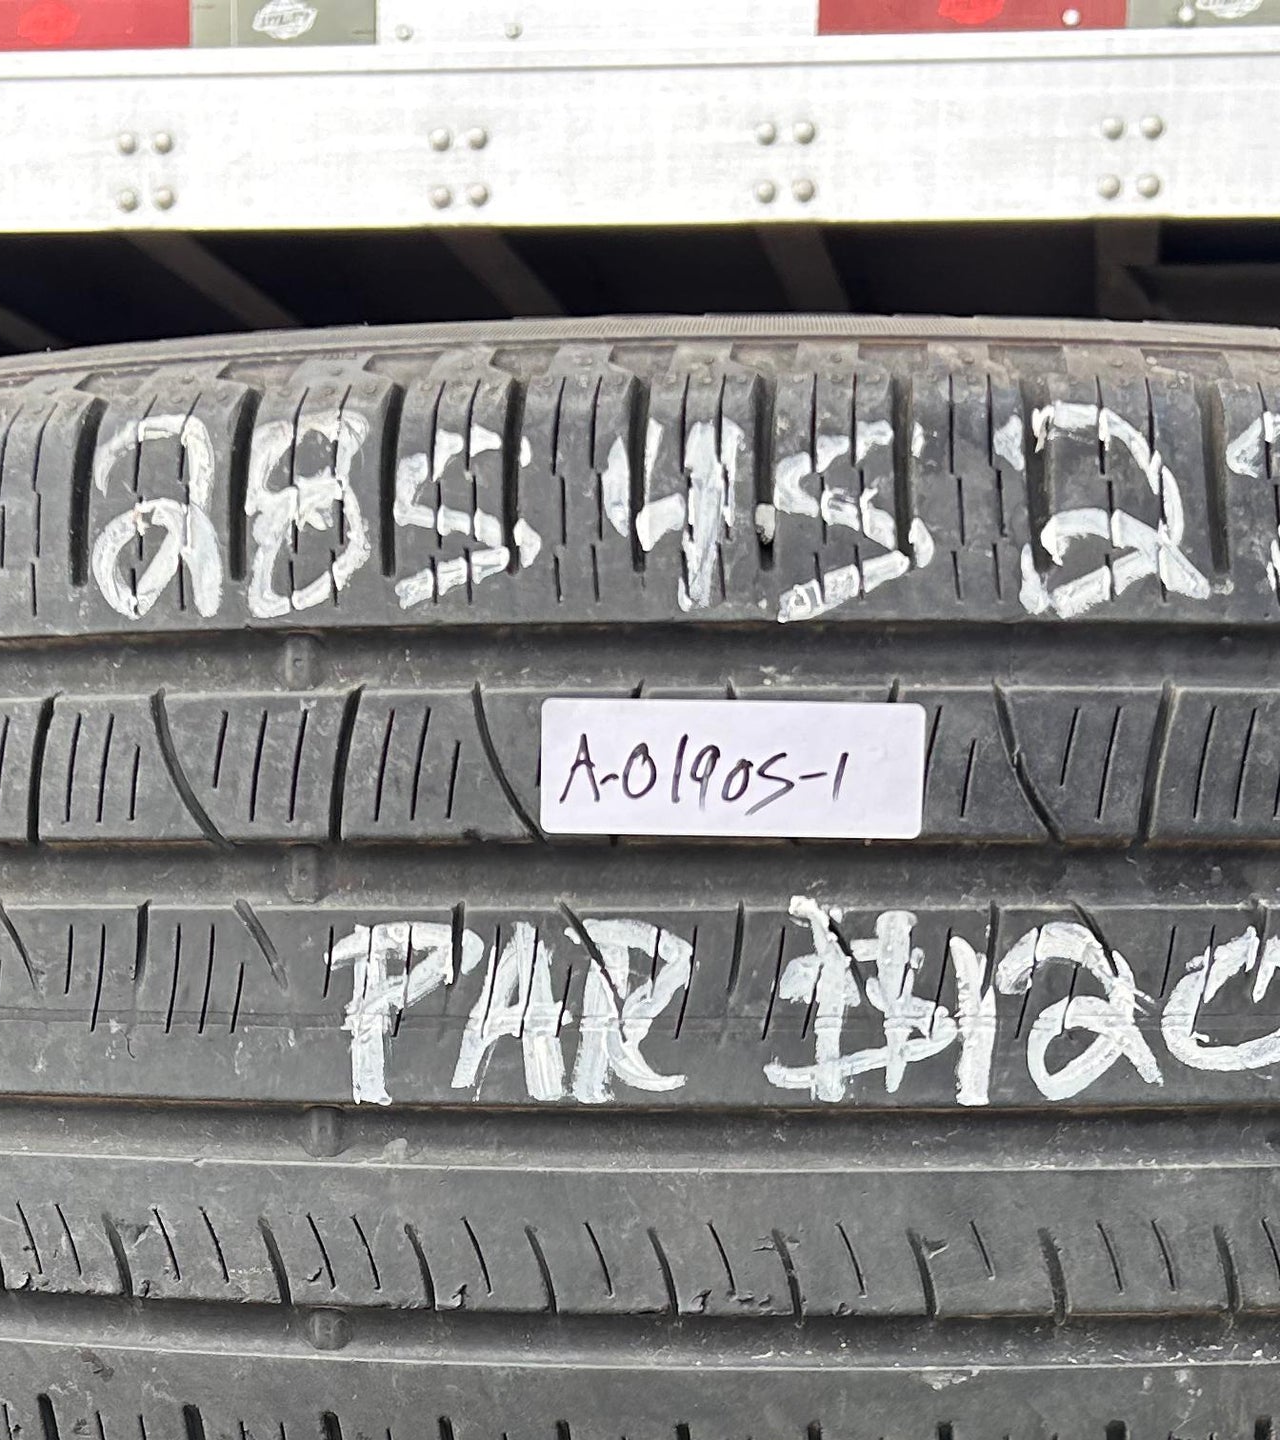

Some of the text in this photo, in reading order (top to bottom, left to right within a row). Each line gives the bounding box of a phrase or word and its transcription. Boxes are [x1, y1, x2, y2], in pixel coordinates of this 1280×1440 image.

[92, 408, 542, 620] 285
[601, 414, 935, 624] 45
[325, 915, 694, 1105] PAR
